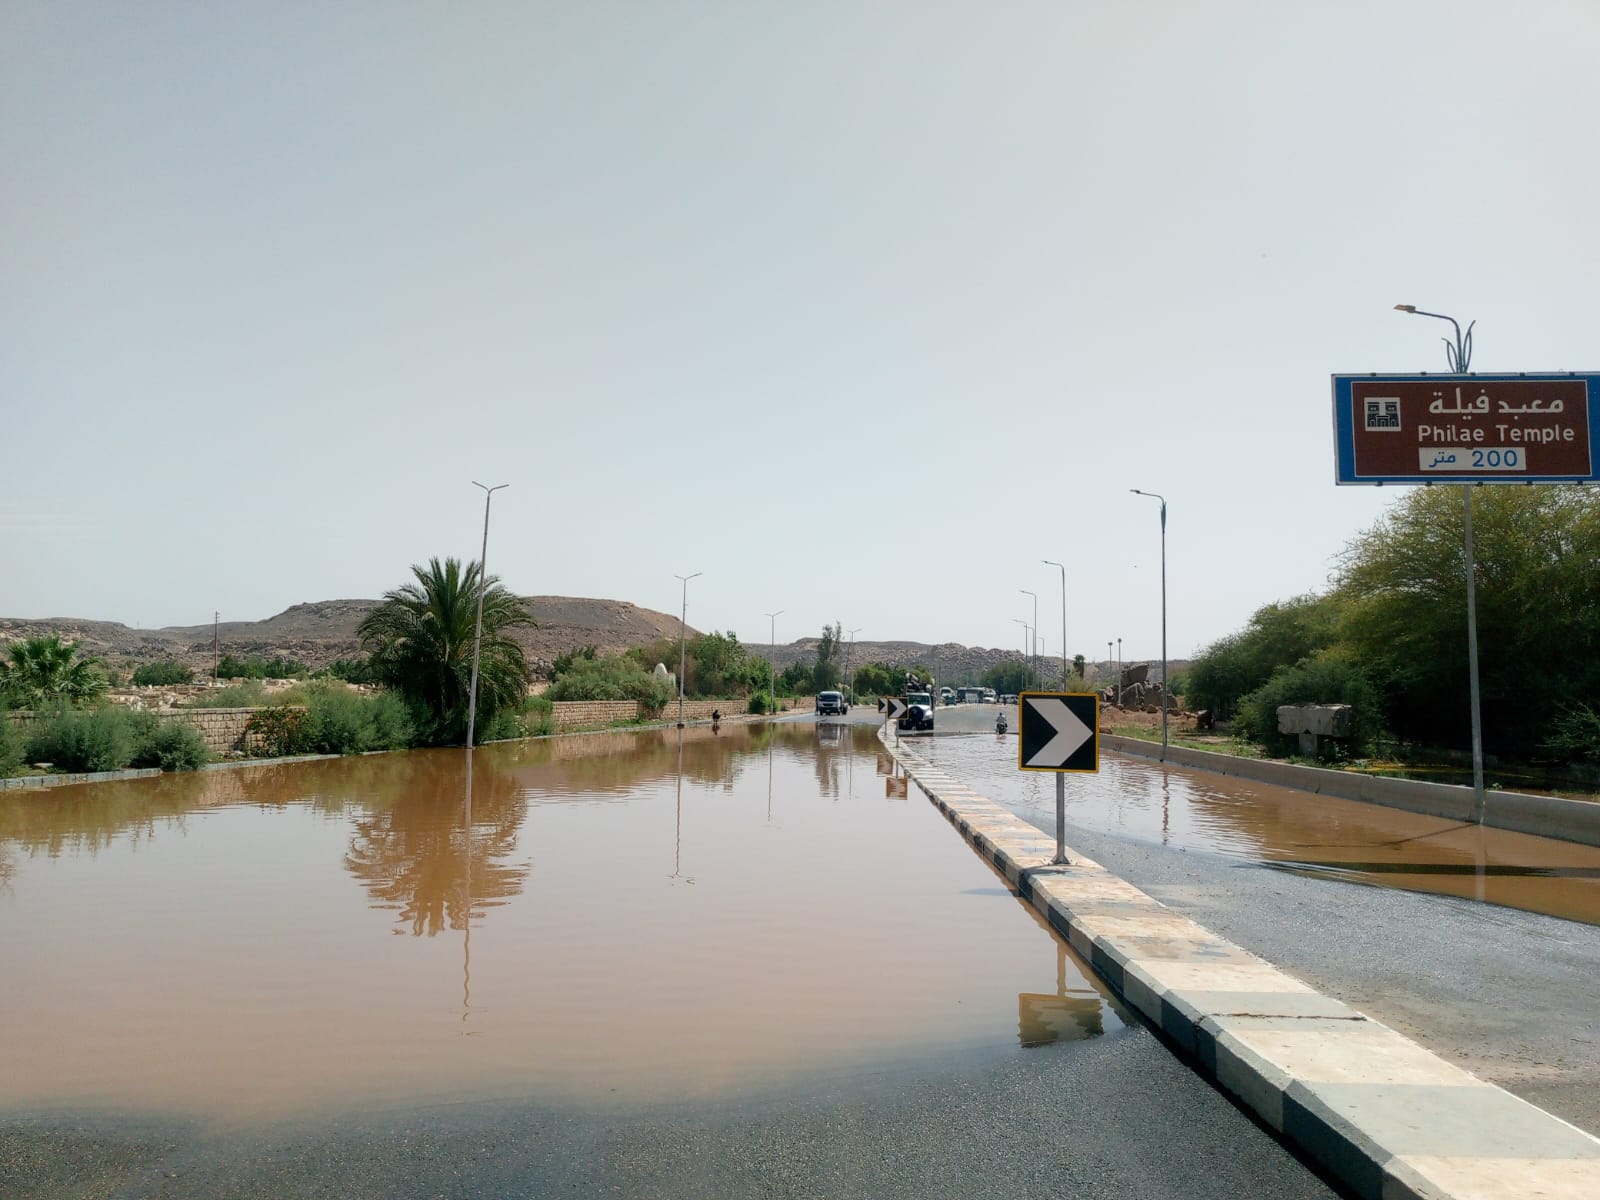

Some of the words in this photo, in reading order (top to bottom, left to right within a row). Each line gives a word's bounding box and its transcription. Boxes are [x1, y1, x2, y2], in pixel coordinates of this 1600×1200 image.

[1428, 387, 1490, 420] فيلة
[1497, 399, 1564, 420] معبد
[1418, 425, 1485, 442] Philae
[1496, 424, 1575, 444] Temple
[1428, 451, 1456, 468] متر
[1471, 449, 1518, 467] 200
